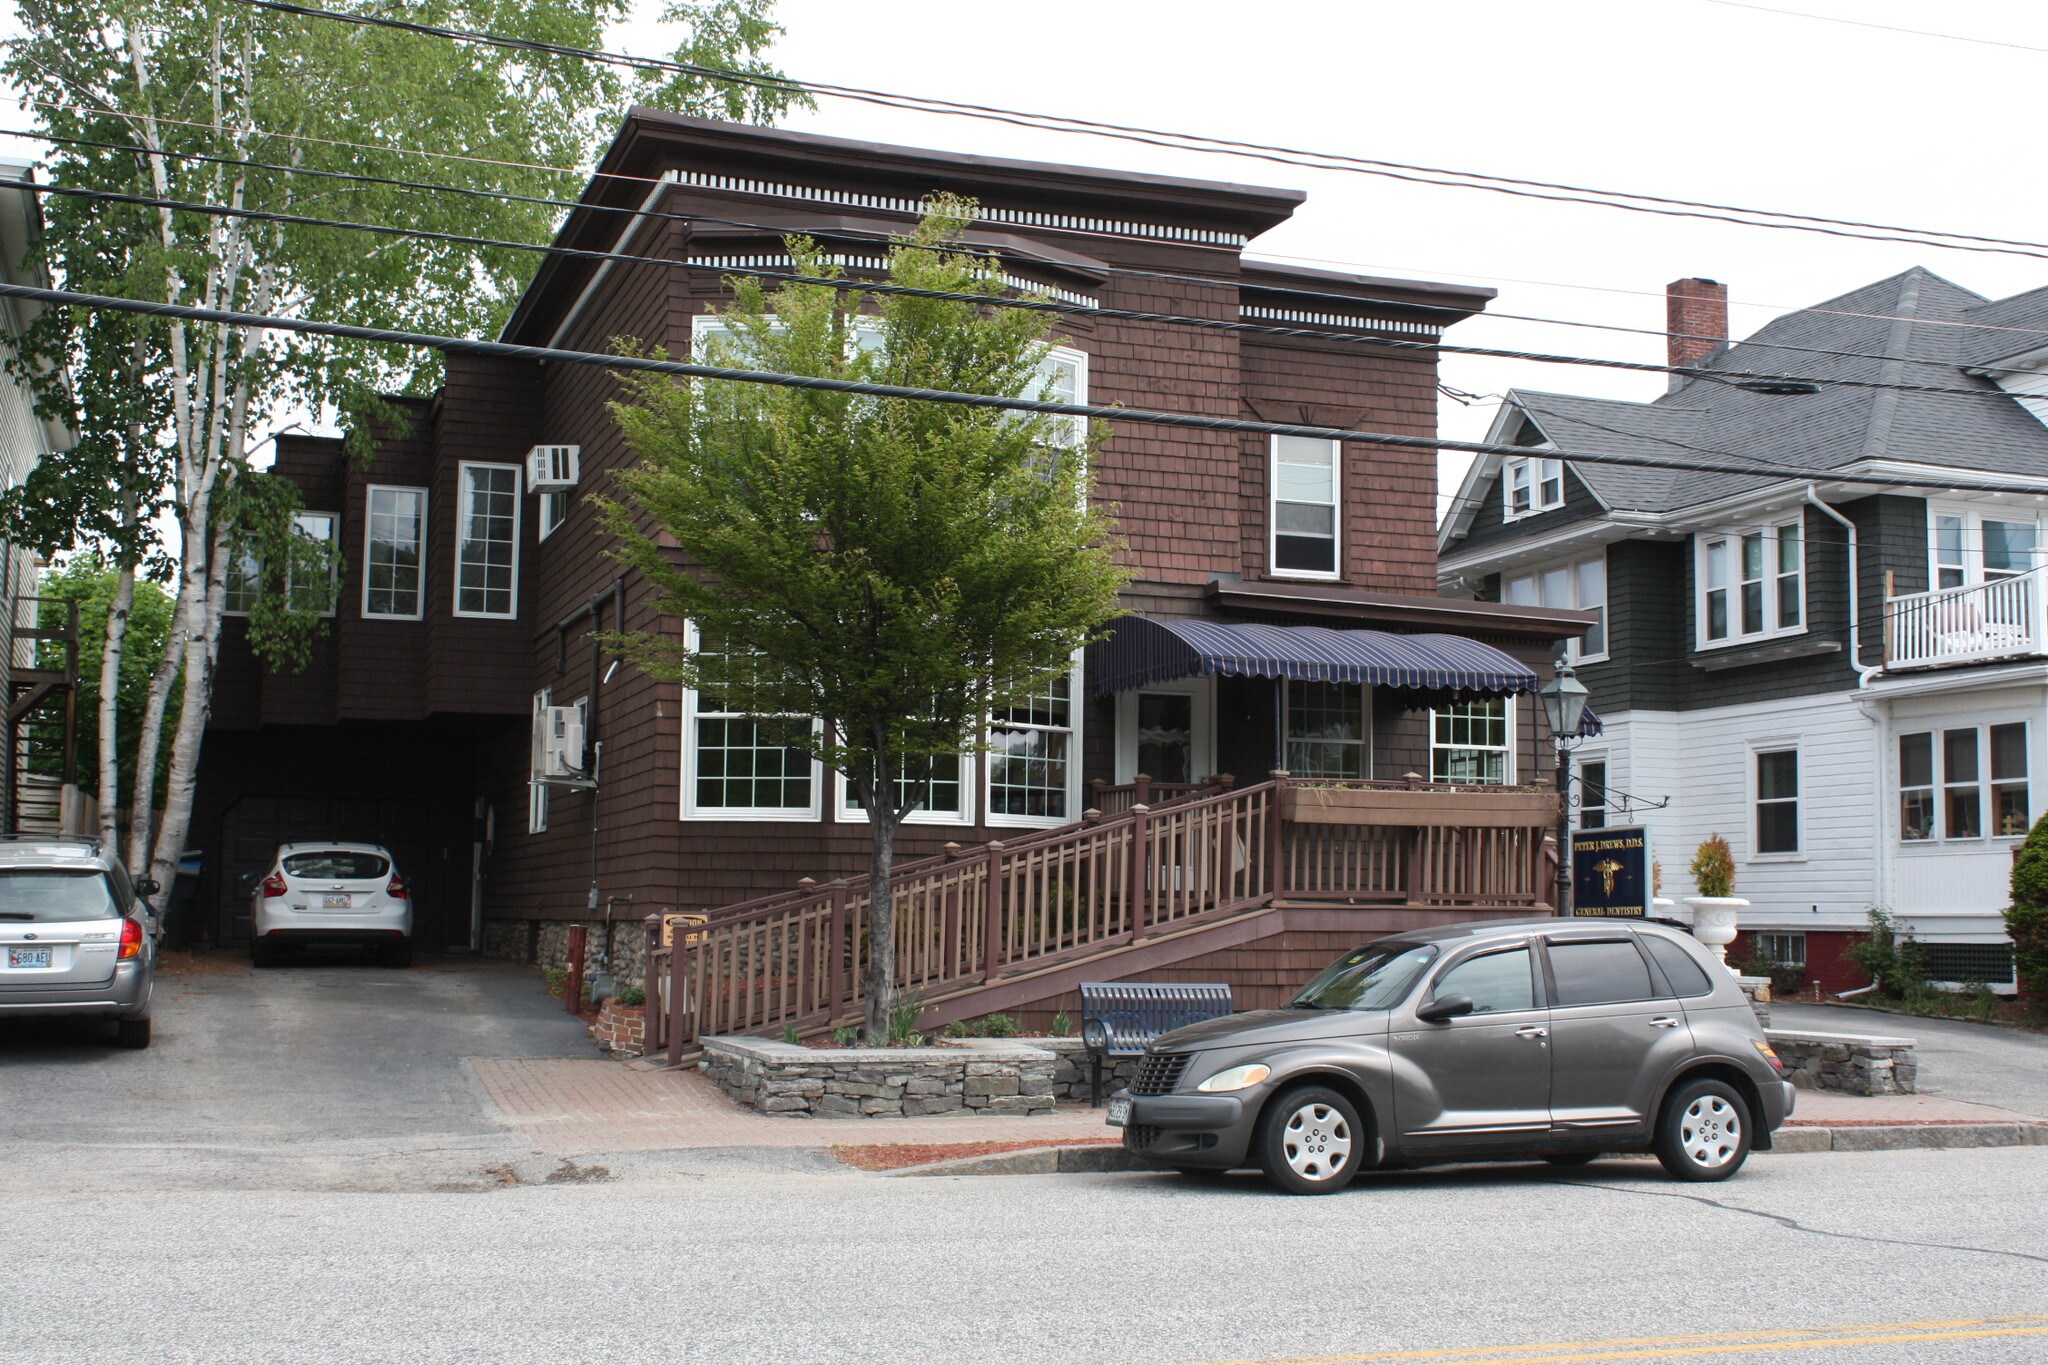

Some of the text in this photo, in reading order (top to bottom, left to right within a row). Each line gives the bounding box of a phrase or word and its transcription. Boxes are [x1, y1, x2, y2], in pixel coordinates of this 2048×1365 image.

[1574, 841, 1594, 851] PETER
[1575, 905, 1643, 916] GENERAL DENTISTRY
[17, 952, 33, 964] 680
